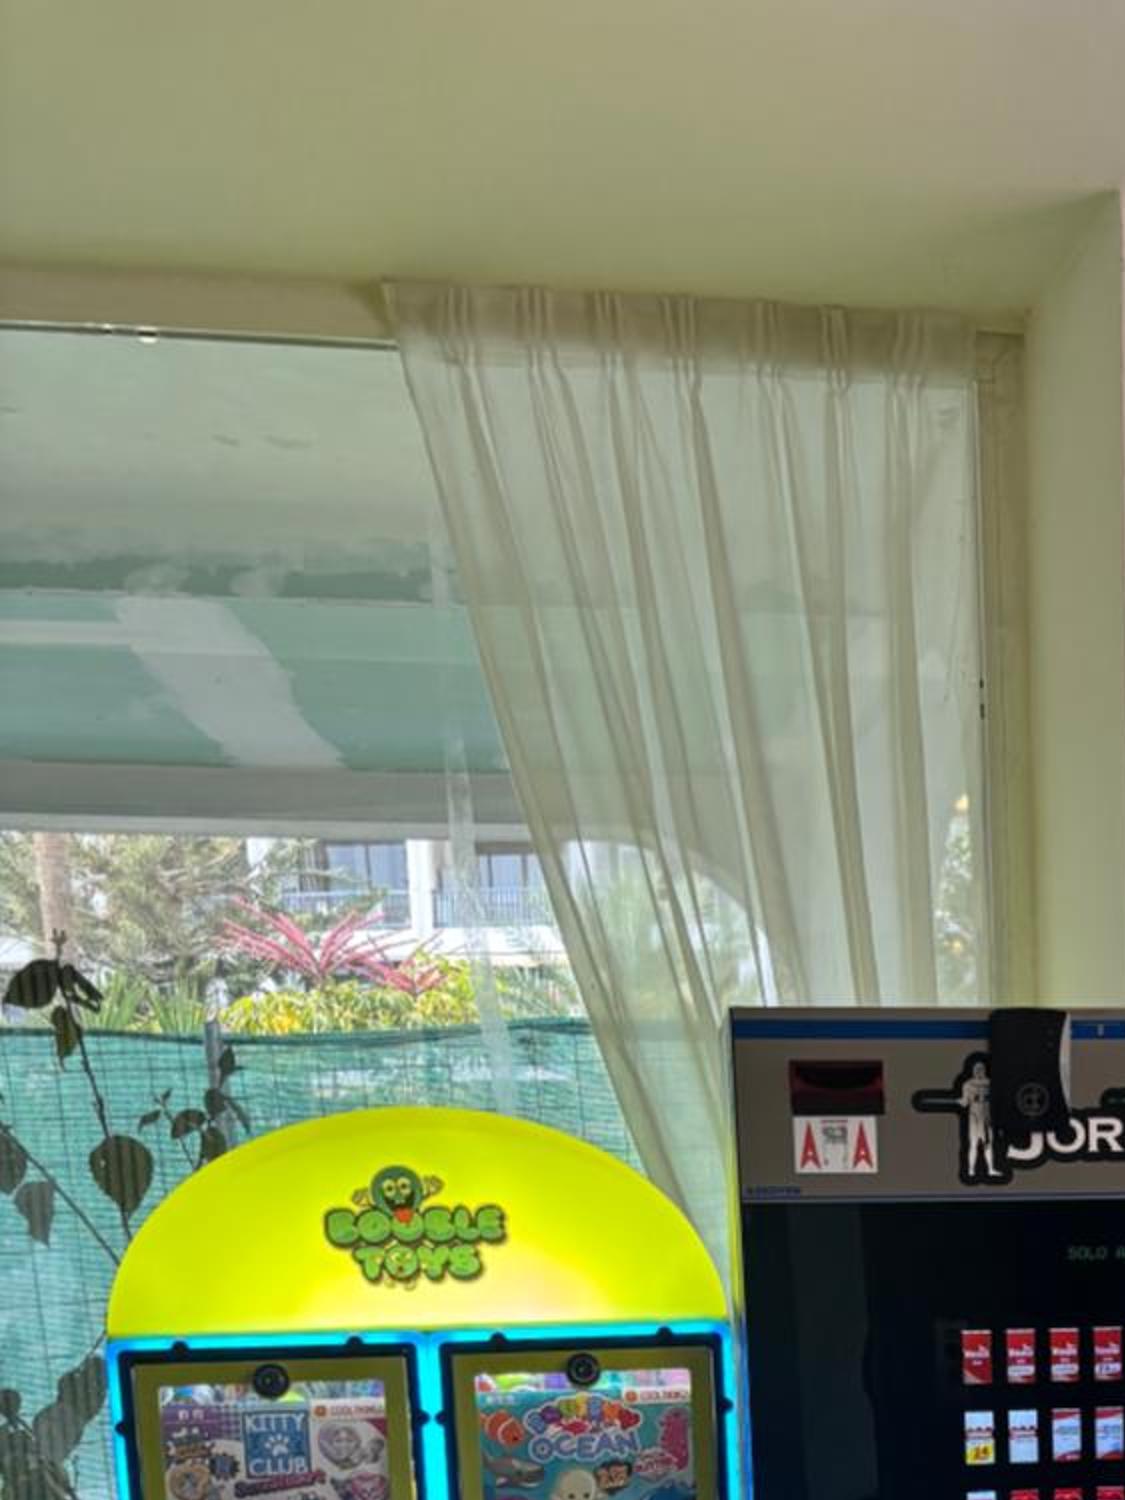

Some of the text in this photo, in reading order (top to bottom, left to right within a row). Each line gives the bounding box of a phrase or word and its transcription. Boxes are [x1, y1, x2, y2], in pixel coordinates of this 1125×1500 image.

[352, 1246, 484, 1284] TOYS
[245, 1413, 305, 1432] KITTY
[528, 1430, 641, 1463] OCEAN
[250, 1457, 308, 1475] CLUB
